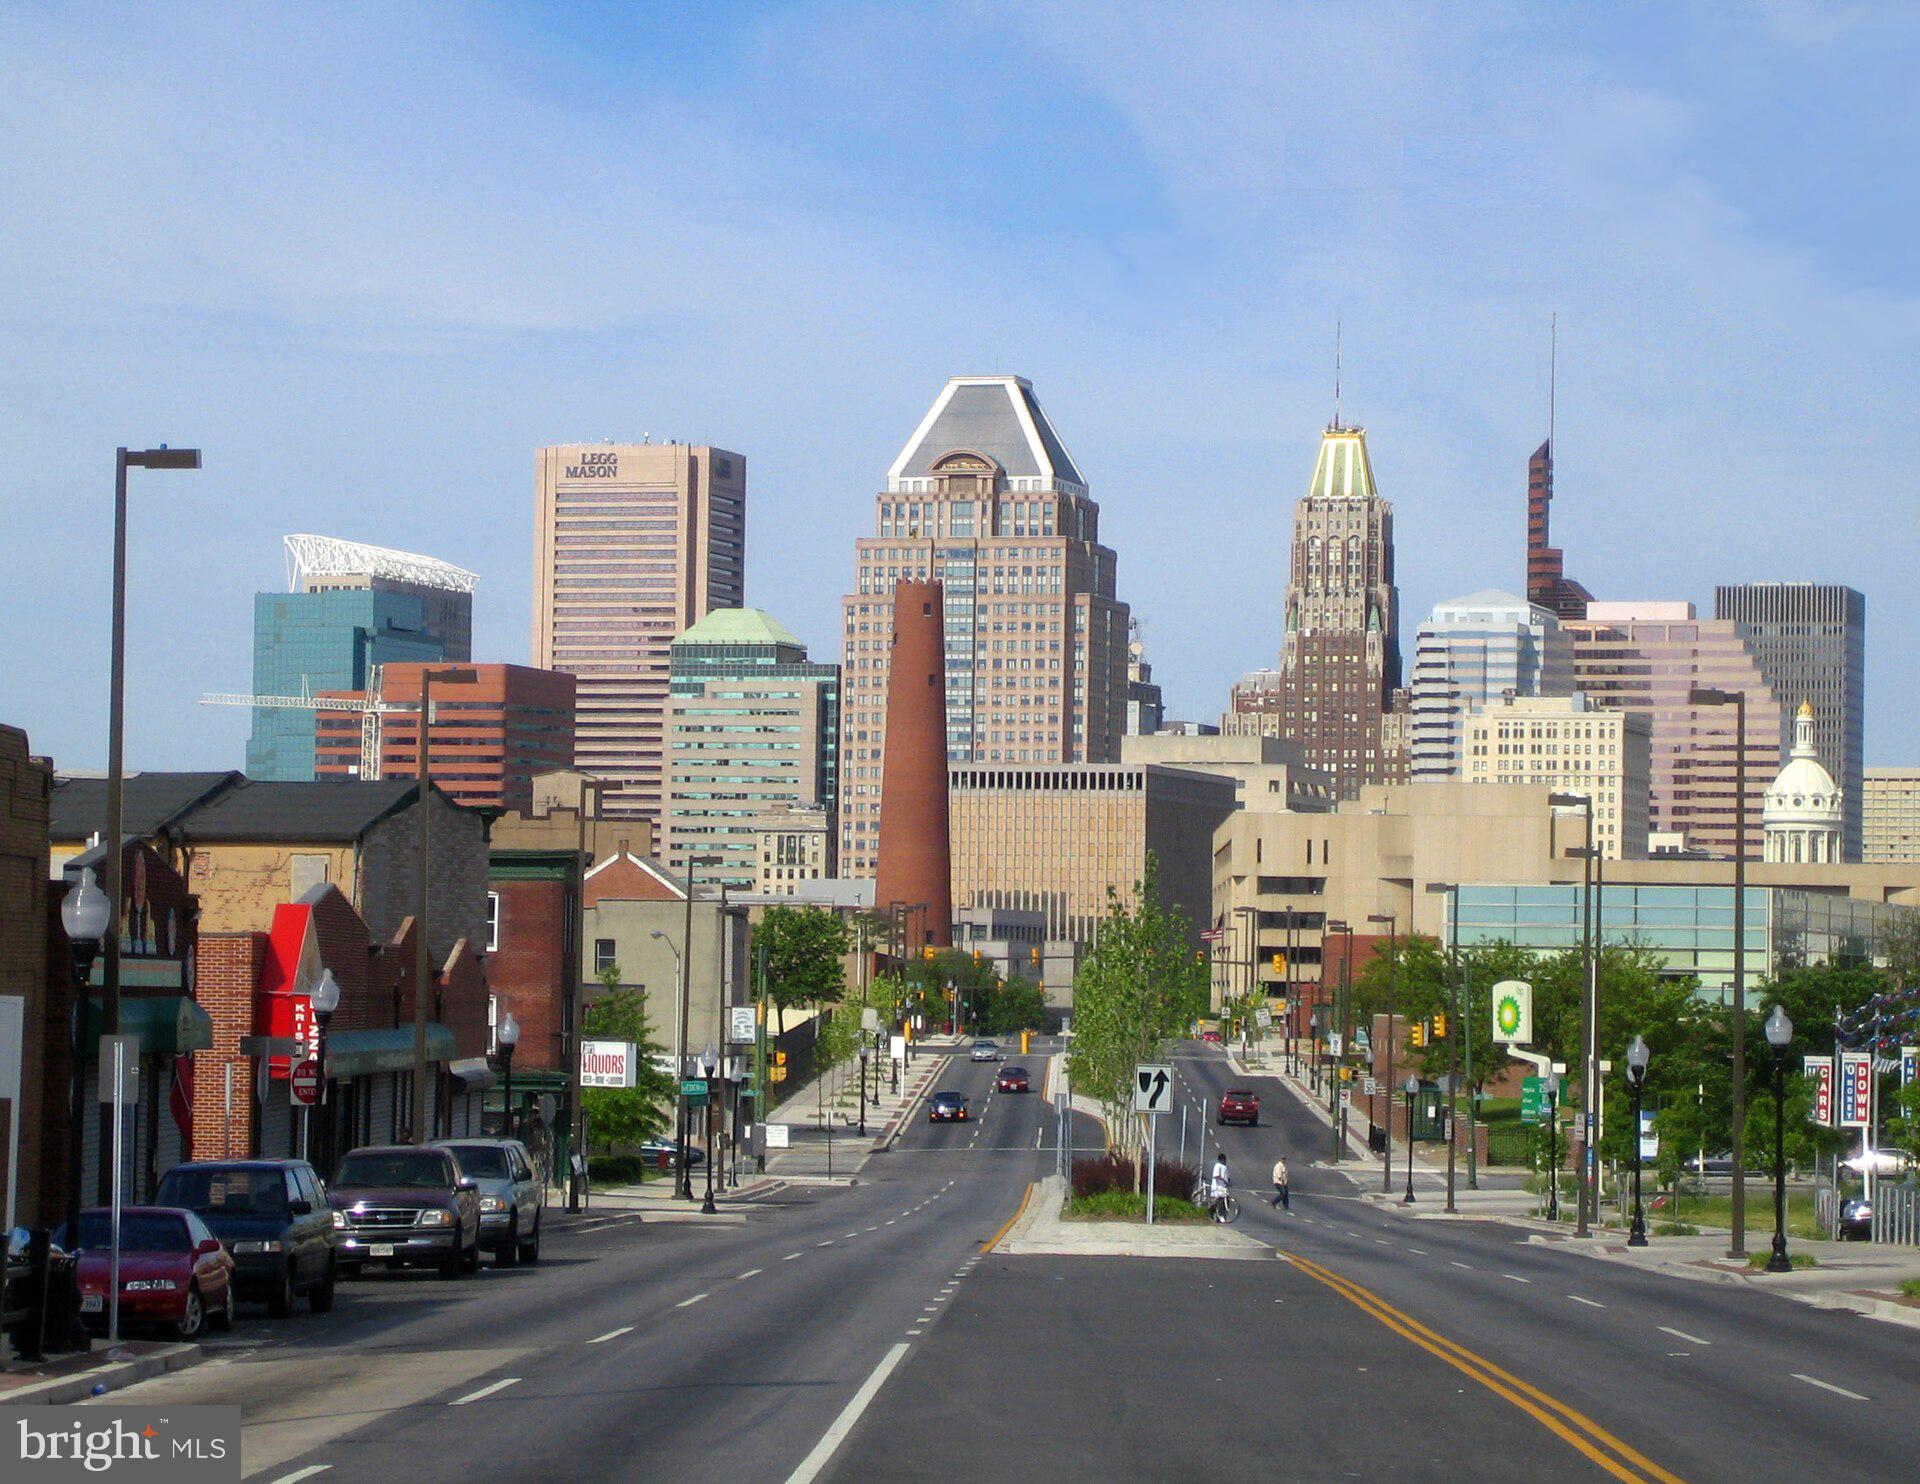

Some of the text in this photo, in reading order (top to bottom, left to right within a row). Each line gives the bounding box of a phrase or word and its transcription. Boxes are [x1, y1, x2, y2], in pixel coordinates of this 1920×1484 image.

[581, 453, 618, 465] LEGG
[565, 466, 617, 478] MASON
[583, 1054, 624, 1075] LIQUORS
[1819, 1068, 1829, 1119] CARS
[1857, 1067, 1867, 1117] DOWN
